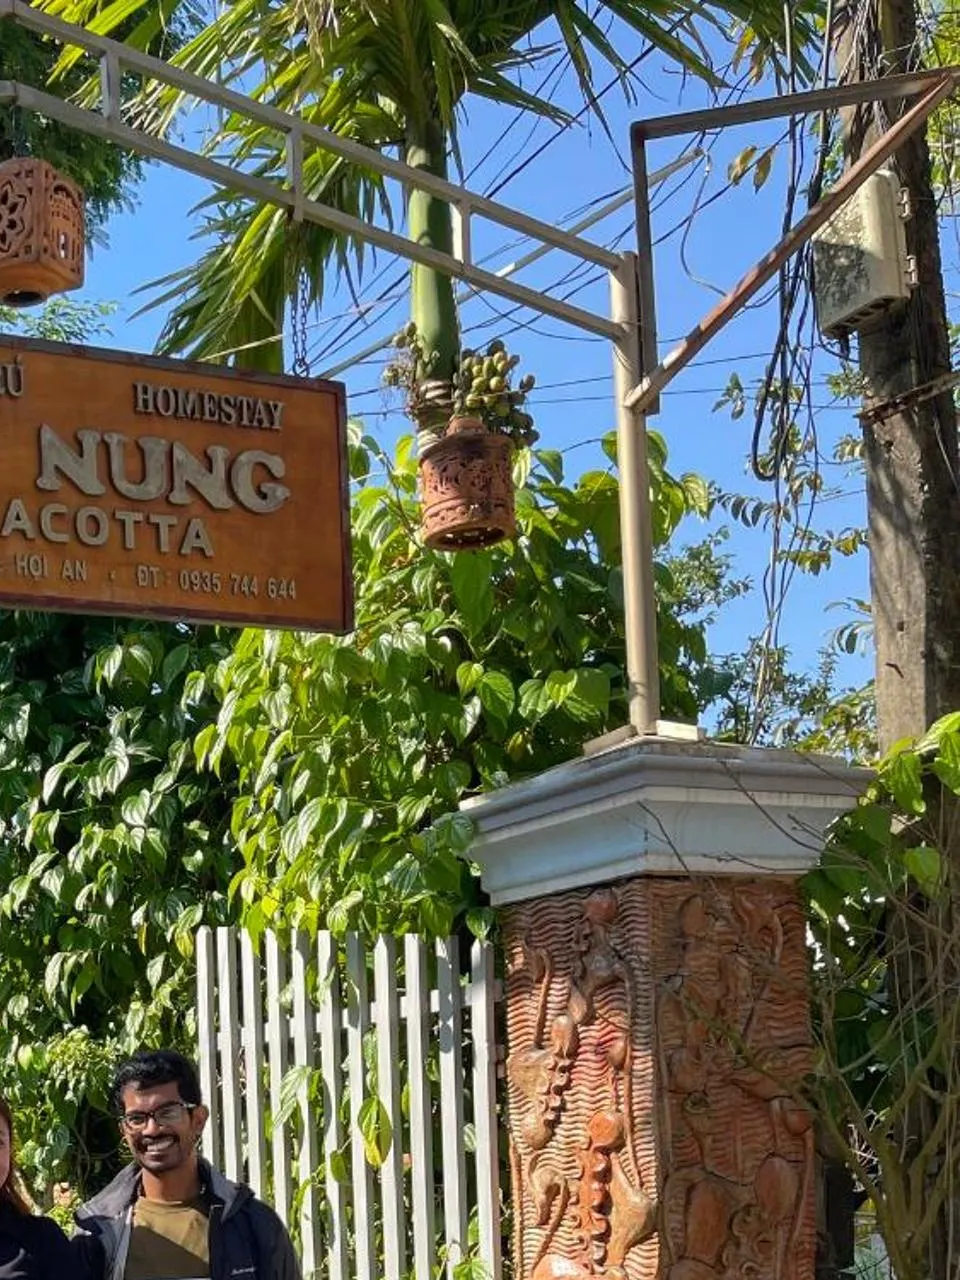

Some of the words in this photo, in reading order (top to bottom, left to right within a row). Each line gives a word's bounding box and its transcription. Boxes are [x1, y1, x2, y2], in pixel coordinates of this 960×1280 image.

[133, 381, 285, 430] HOMESTAY
[36, 422, 290, 514] NUNG
[62, 559, 88, 581] AN
[179, 569, 221, 593] 0935
[230, 574, 258, 597] 744
[267, 577, 297, 600] 644
